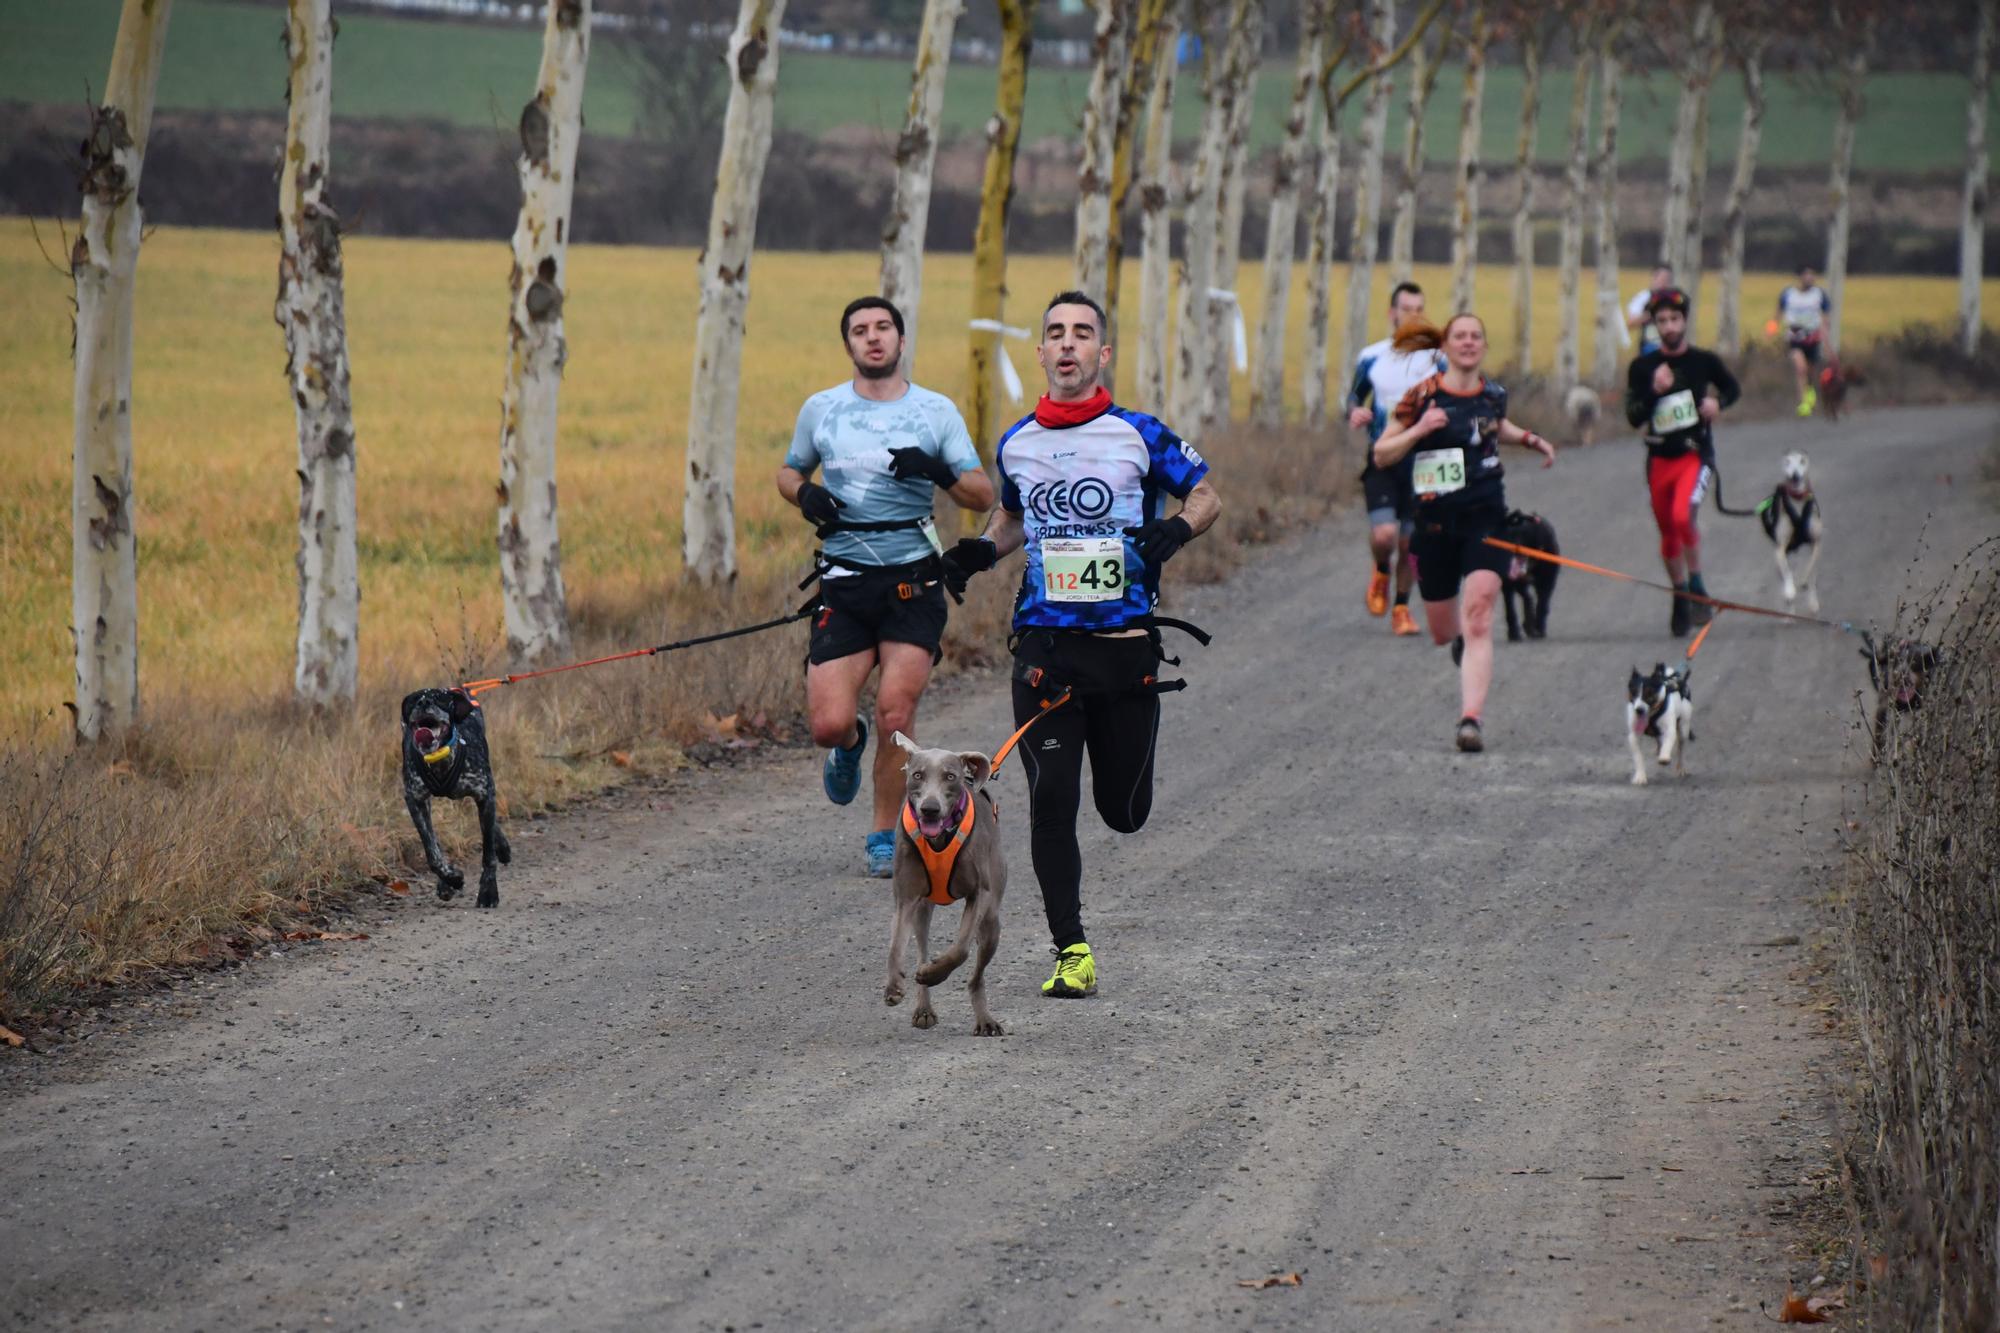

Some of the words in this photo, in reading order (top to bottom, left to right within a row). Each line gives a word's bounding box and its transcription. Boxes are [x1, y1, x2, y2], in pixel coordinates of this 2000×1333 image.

[1436, 462, 1462, 483] 13
[1047, 572, 1078, 590] 112
[1080, 559, 1122, 590] 43
